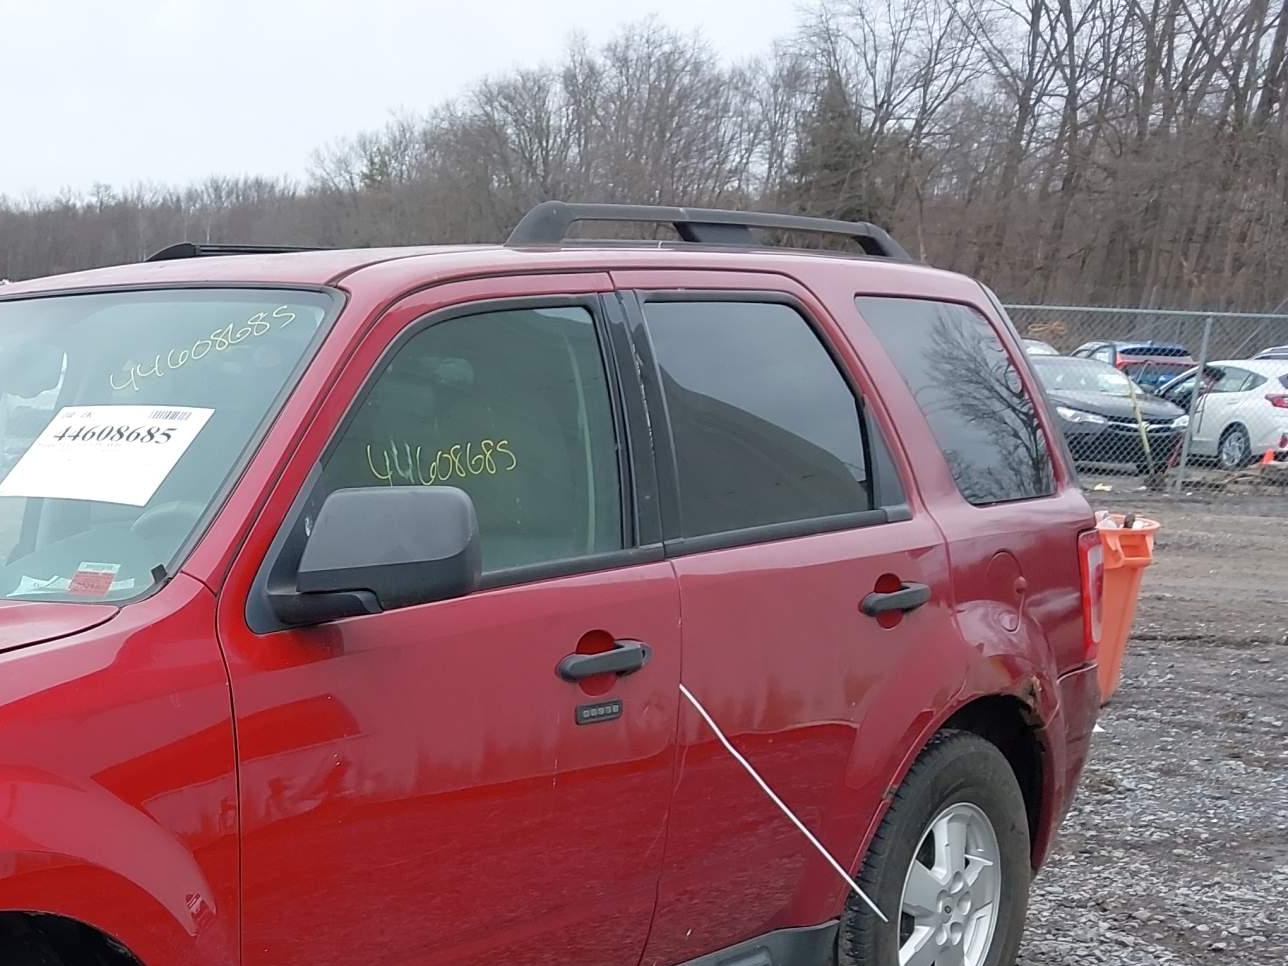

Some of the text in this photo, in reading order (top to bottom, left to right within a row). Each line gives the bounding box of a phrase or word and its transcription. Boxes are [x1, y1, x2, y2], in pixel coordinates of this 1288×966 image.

[110, 305, 296, 391] 44608685
[53, 425, 178, 445] 44608685
[367, 439, 517, 488] 44608685
